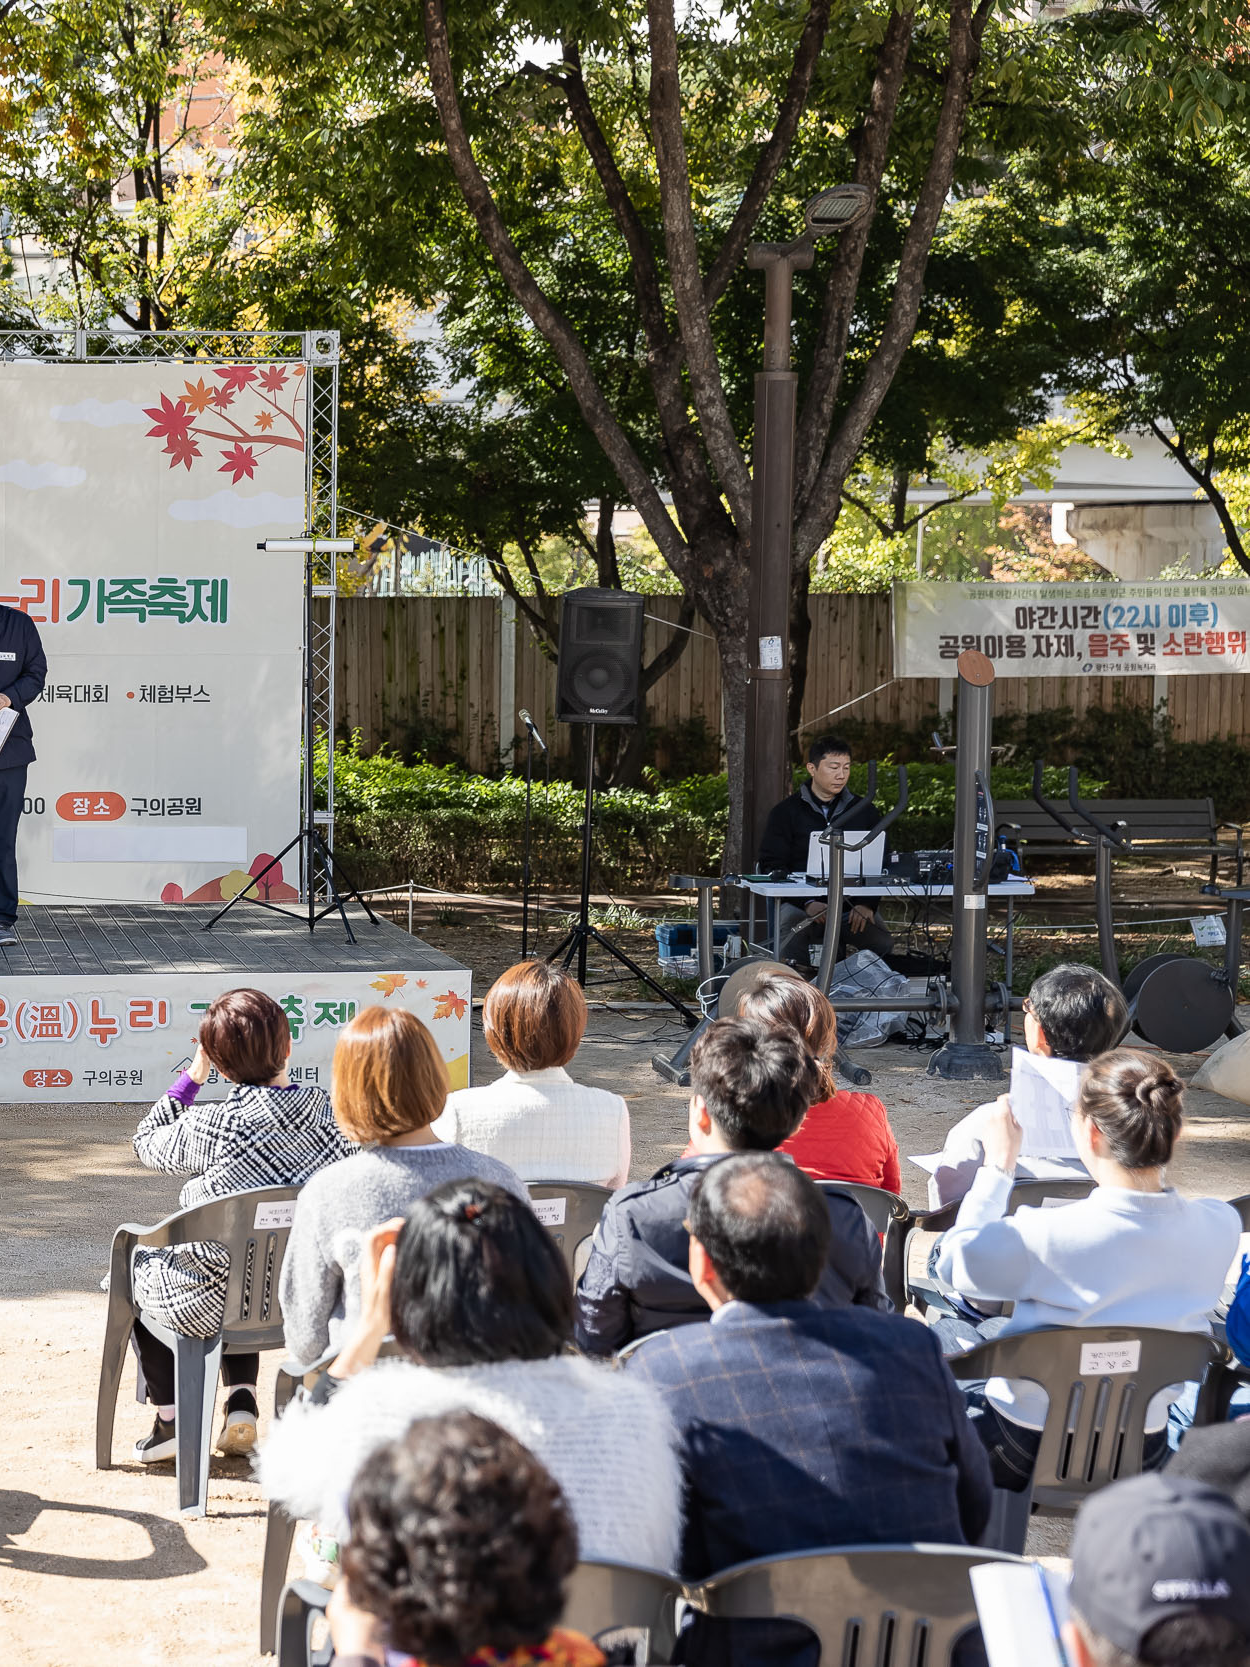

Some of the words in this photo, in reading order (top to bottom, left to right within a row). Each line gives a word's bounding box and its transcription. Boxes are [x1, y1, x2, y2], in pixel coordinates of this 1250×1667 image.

[66, 577, 228, 624] 가족축제
[1168, 602, 1218, 628] 이후)
[938, 634, 1027, 660] 공원이용
[1032, 633, 1083, 661] 자제,
[1088, 632, 1131, 658] 음주
[1136, 632, 1156, 657] 및
[1162, 629, 1247, 657] 소란행위
[138, 684, 211, 704] 체험부스
[72, 797, 111, 816] 장소
[130, 797, 202, 817] 구의공원
[32, 1070, 67, 1088] 장소
[82, 1069, 143, 1087] 구의공원
